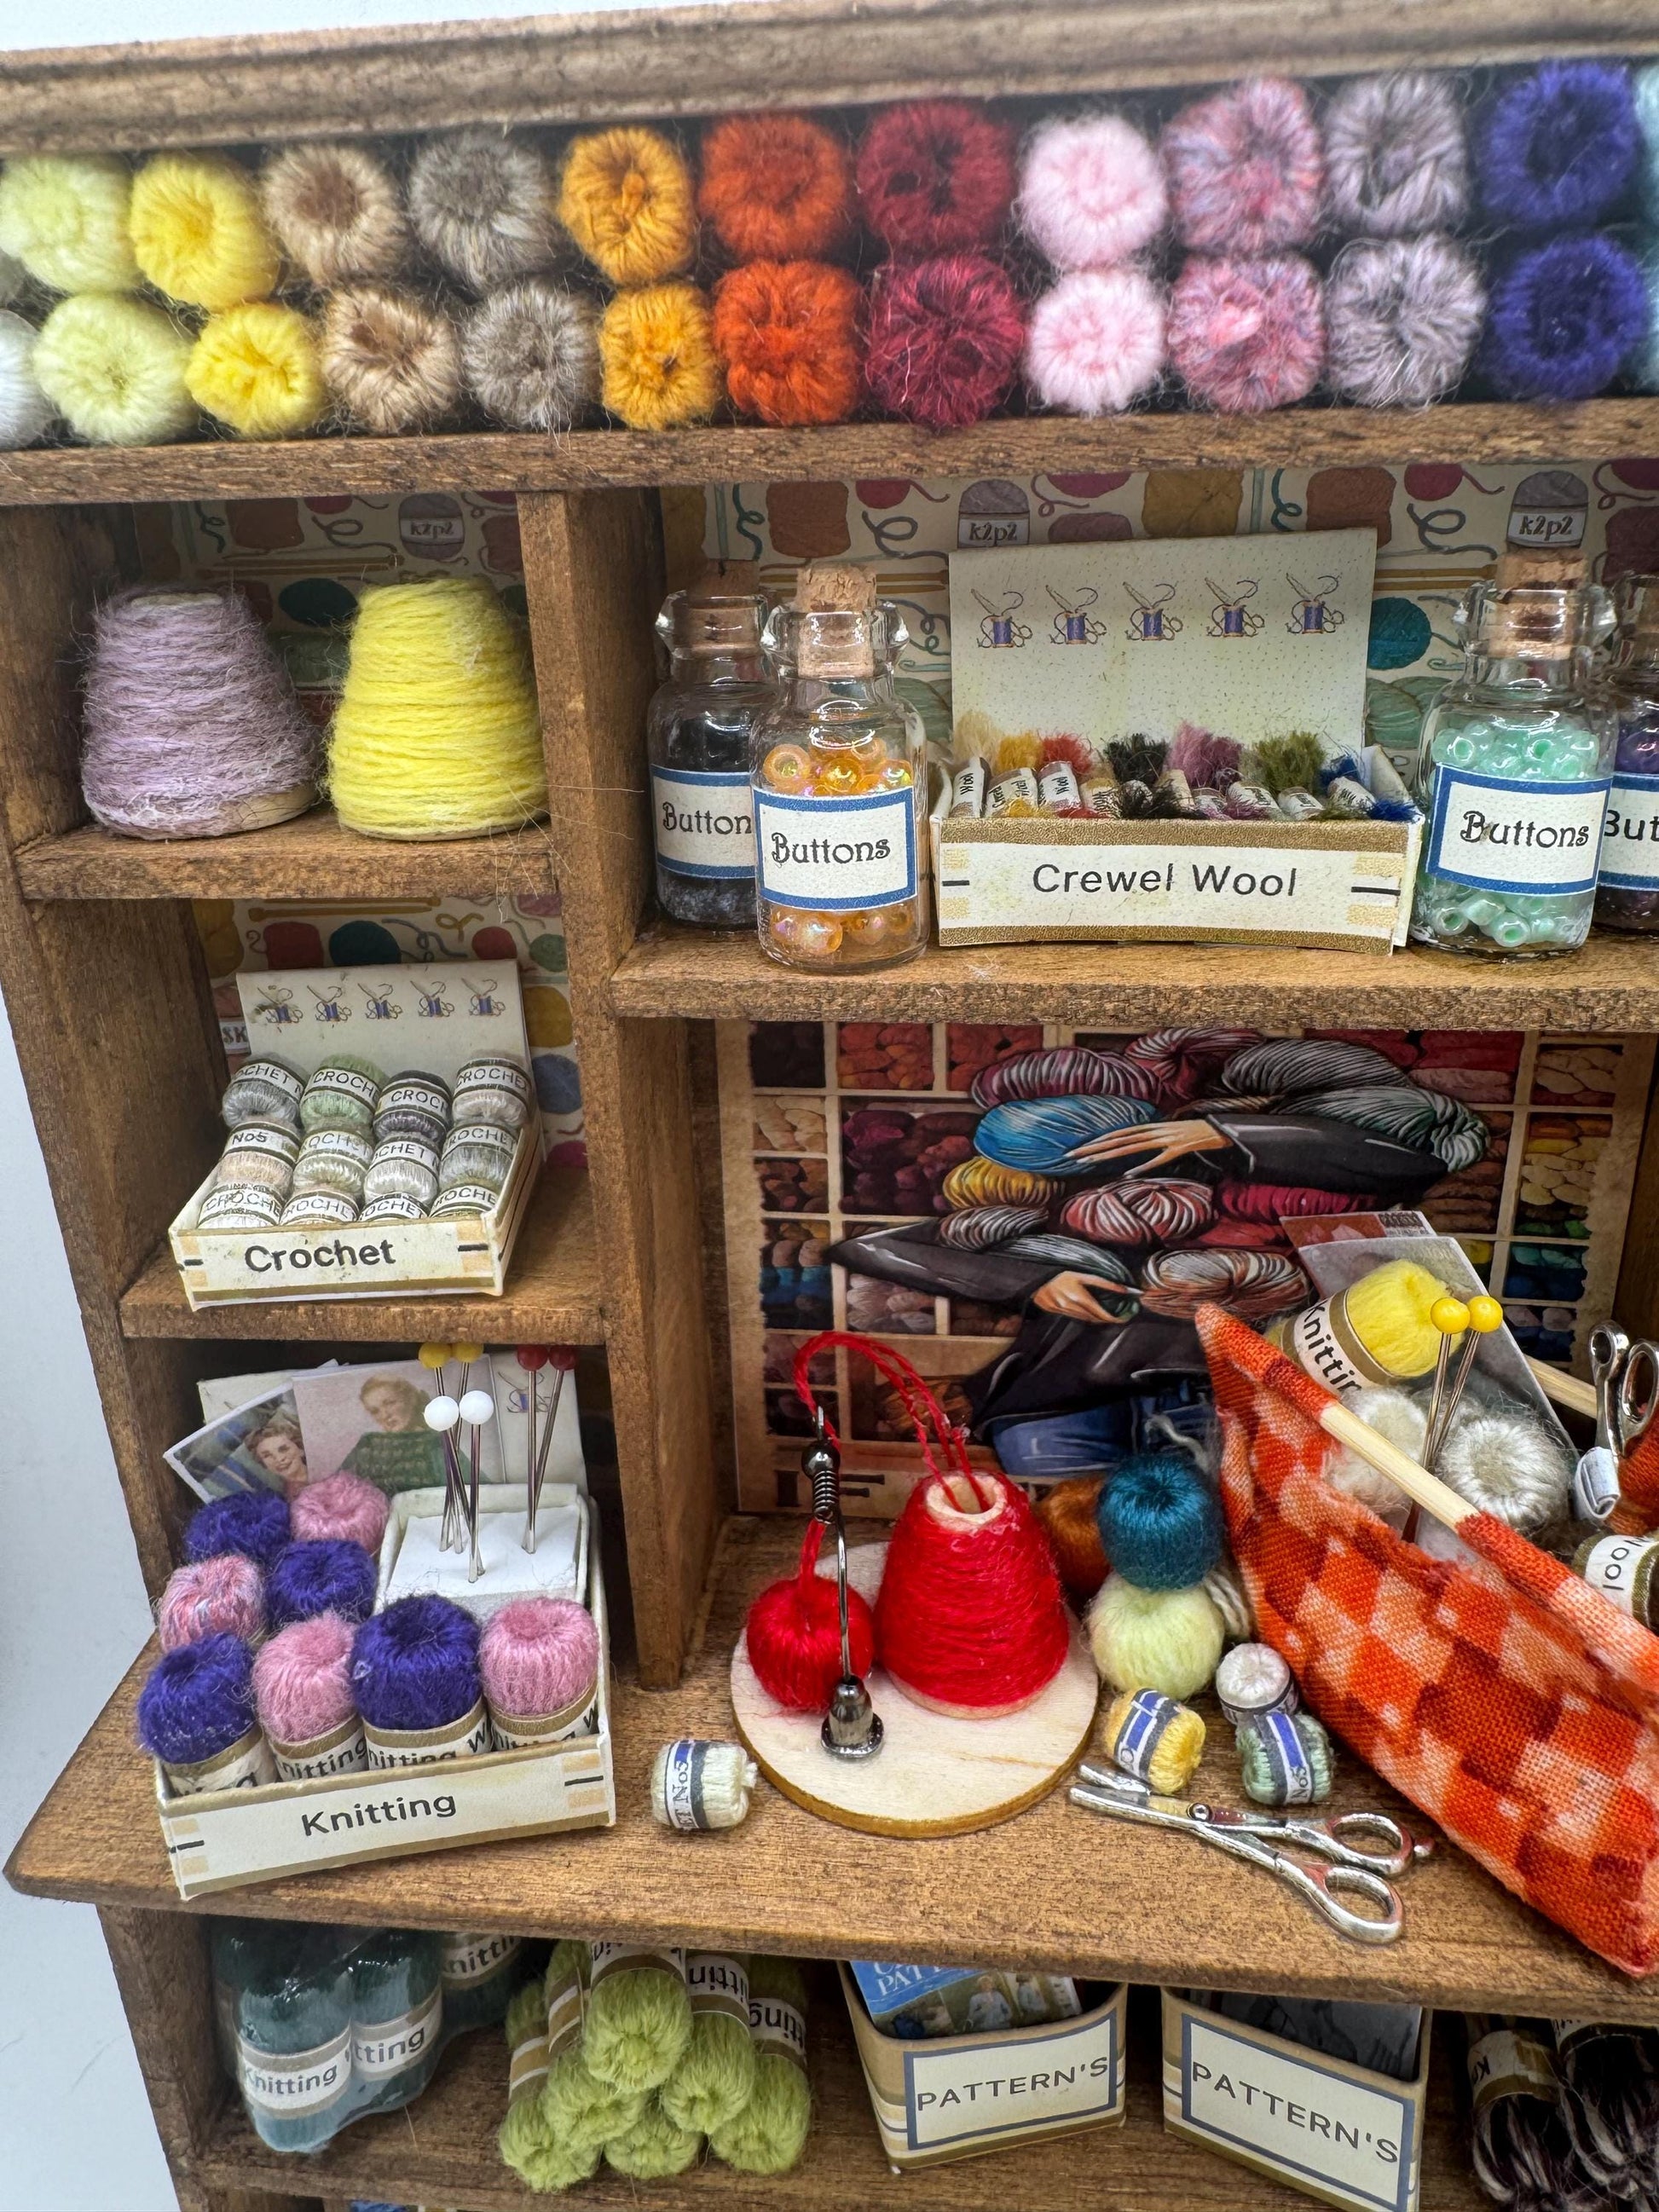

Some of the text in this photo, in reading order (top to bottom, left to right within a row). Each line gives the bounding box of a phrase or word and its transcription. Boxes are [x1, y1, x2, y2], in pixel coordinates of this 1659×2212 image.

[968, 522, 1017, 546] k2p2
[1519, 516, 1573, 540] k2p2
[1460, 811, 1590, 848] Buttons
[771, 832, 891, 864] Buttons
[1032, 863, 1297, 897] Crewel Wool
[245, 1239, 396, 1272] Crochet
[301, 1796, 457, 1836] Knitting
[876, 1964, 942, 1996] PAT
[917, 2056, 1108, 2111] PATTERN'S
[1193, 2061, 1398, 2163] PATTERN'S
